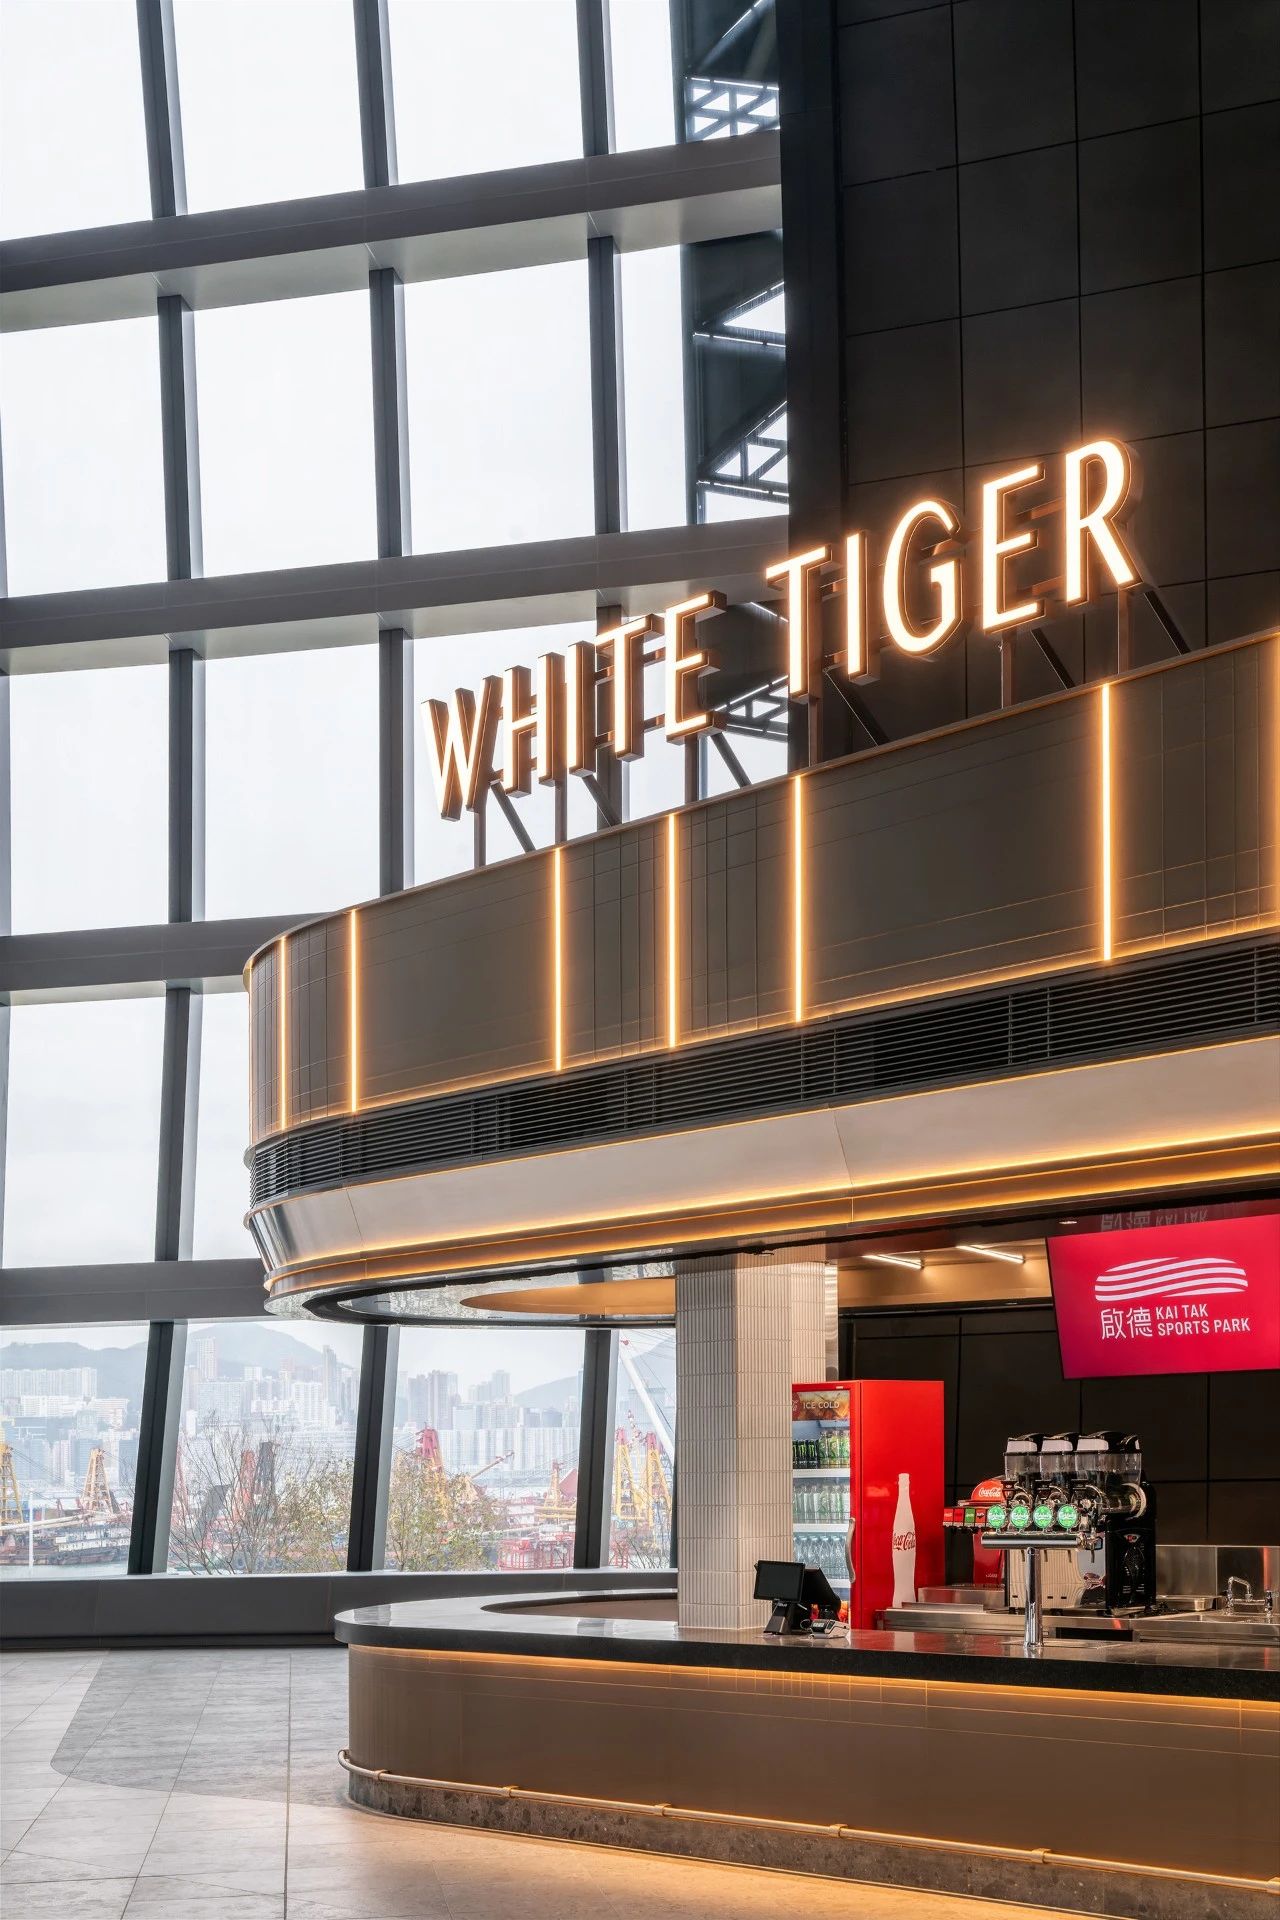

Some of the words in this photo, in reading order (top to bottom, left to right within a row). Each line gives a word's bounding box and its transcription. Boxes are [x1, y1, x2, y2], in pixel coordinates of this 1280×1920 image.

[420, 591, 727, 821] WHITE
[766, 439, 1143, 702] TIGER
[1155, 1306, 1179, 1320] KAI
[1182, 1304, 1208, 1318] TAK
[1158, 1320, 1210, 1337] SPORTS
[1214, 1318, 1250, 1332] PARK
[803, 1401, 816, 1409] ICE
[818, 1401, 840, 1409] COLD
